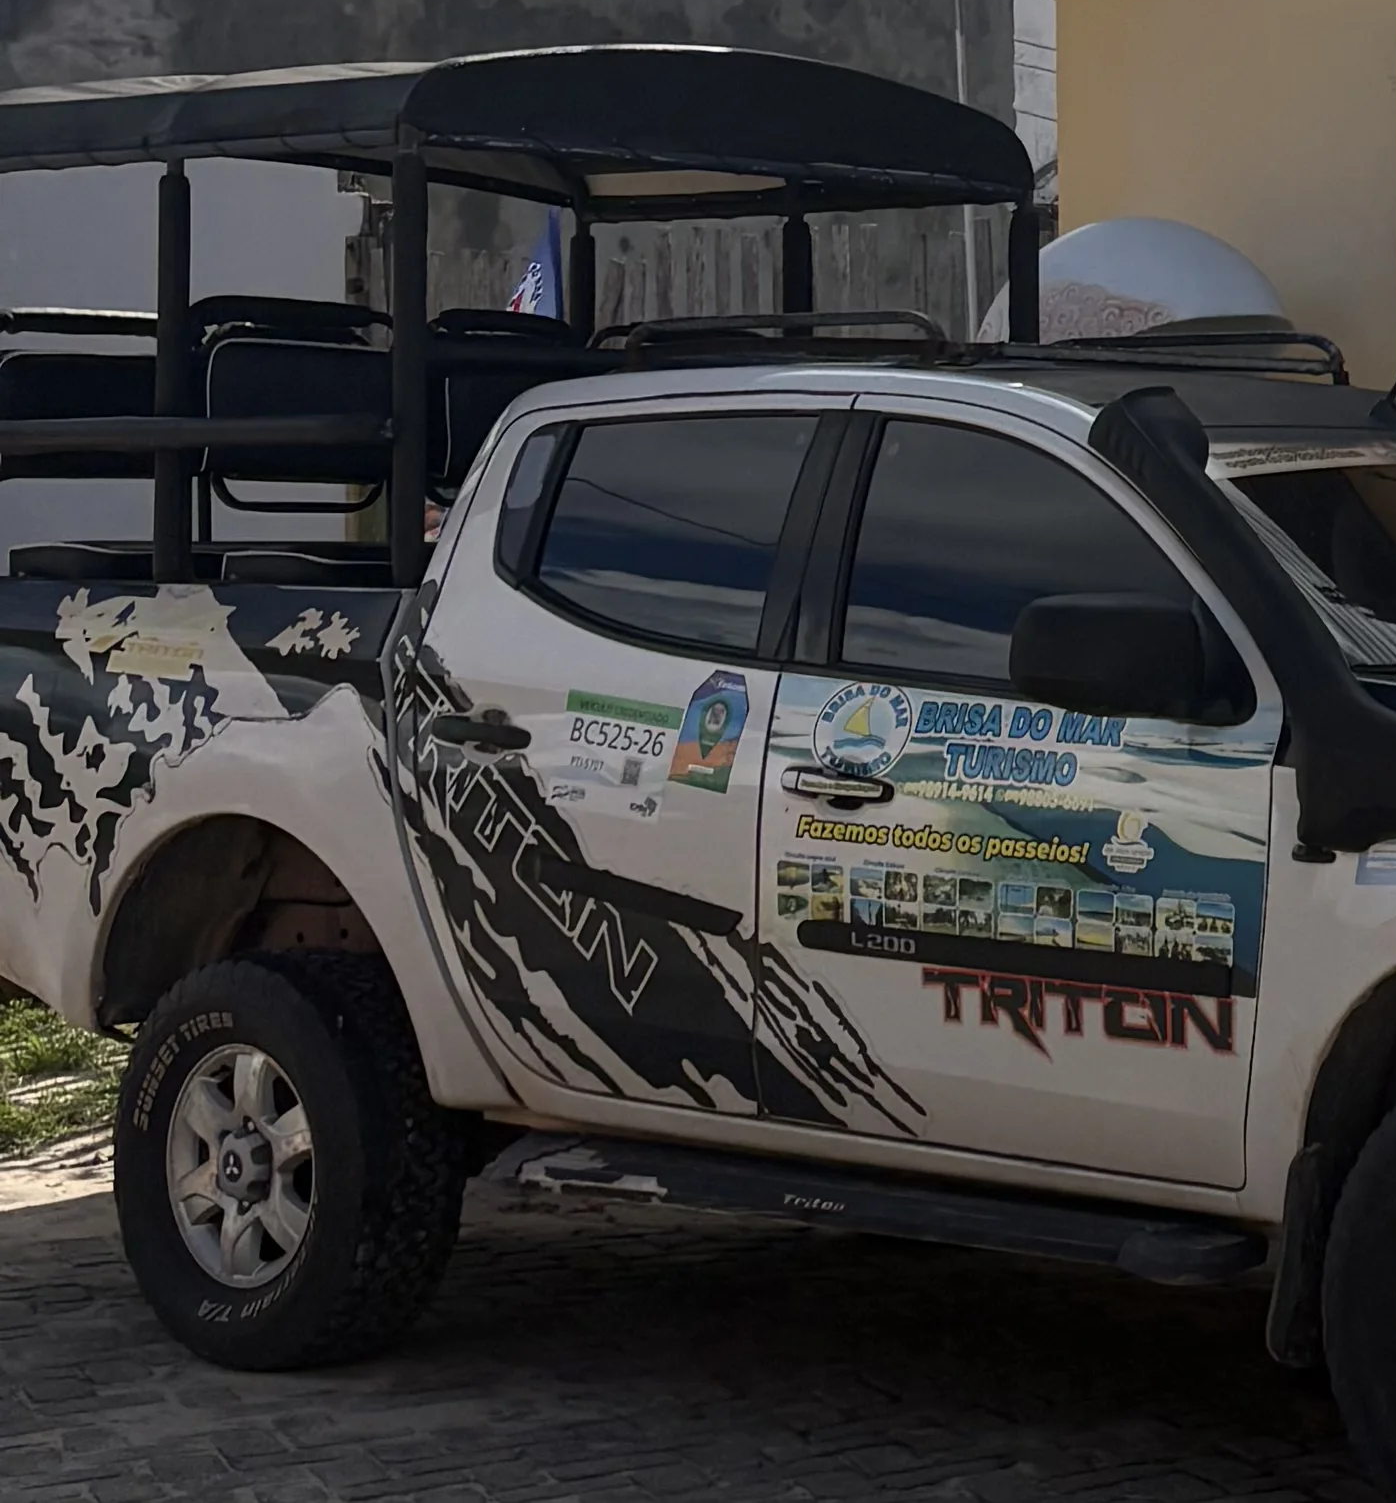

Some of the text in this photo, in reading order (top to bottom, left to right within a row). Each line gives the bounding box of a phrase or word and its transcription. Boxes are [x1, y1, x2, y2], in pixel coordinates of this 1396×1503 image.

[570, 717, 666, 757] BC525-26
[915, 701, 1127, 746] BRISA DO MAR
[946, 743, 1077, 786] TURISMO
[797, 816, 888, 845] Fazemos
[894, 825, 953, 852] todos
[957, 832, 981, 854] os
[986, 835, 1091, 864] passeios!
[850, 931, 916, 954] L200
[179, 1012, 233, 1041] TIRES
[922, 966, 1239, 1062] TRITON
